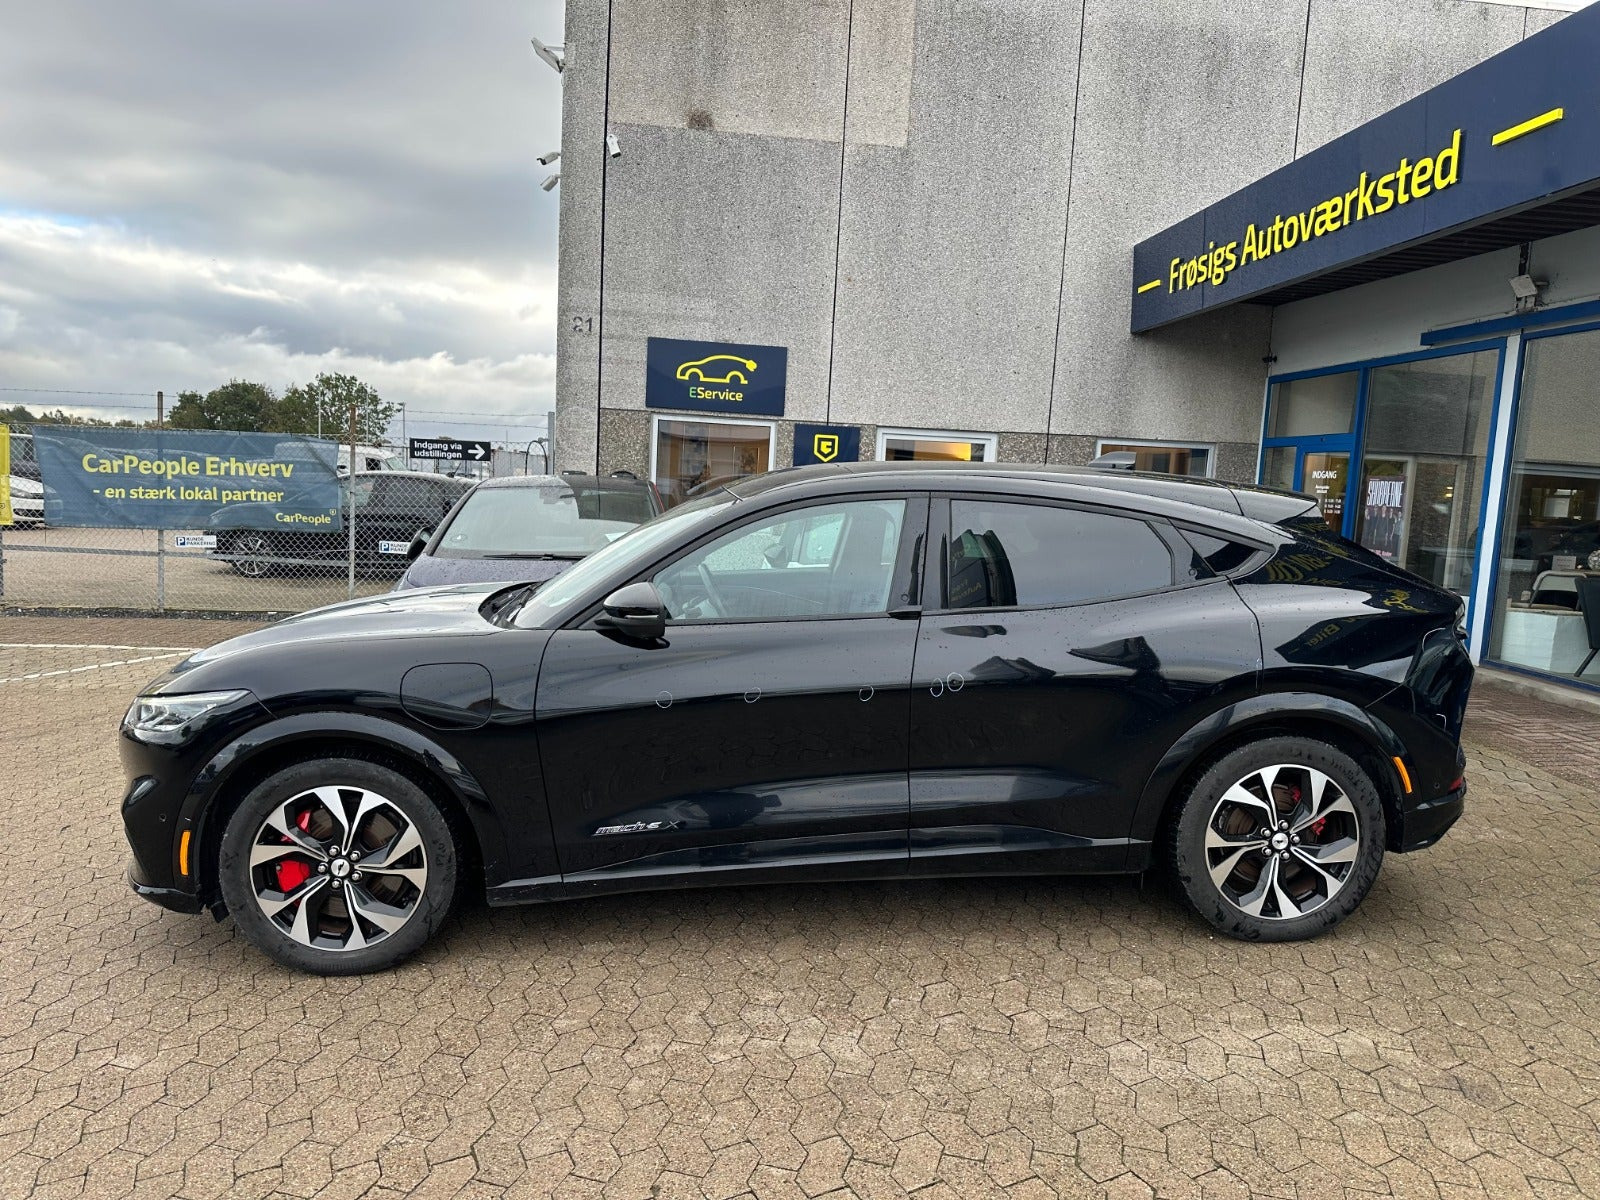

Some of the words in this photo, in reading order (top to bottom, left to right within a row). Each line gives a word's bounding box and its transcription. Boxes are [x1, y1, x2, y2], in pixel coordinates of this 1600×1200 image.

[1168, 240, 1237, 294] Frøsigs
[1240, 128, 1462, 266] Autoværksted
[572, 316, 593, 332] 21
[689, 386, 743, 401] EService
[414, 440, 448, 451] Indgang
[450, 442, 462, 450] via
[414, 450, 462, 459] udstillingen
[82, 453, 200, 480] CarPeople
[205, 456, 294, 478] Erhverv
[1311, 470, 1337, 479] INDGANG
[104, 487, 126, 499] en
[129, 486, 176, 500] stærk
[180, 486, 218, 501] lokal
[221, 488, 284, 504] partner
[275, 512, 331, 526] CarPeople
